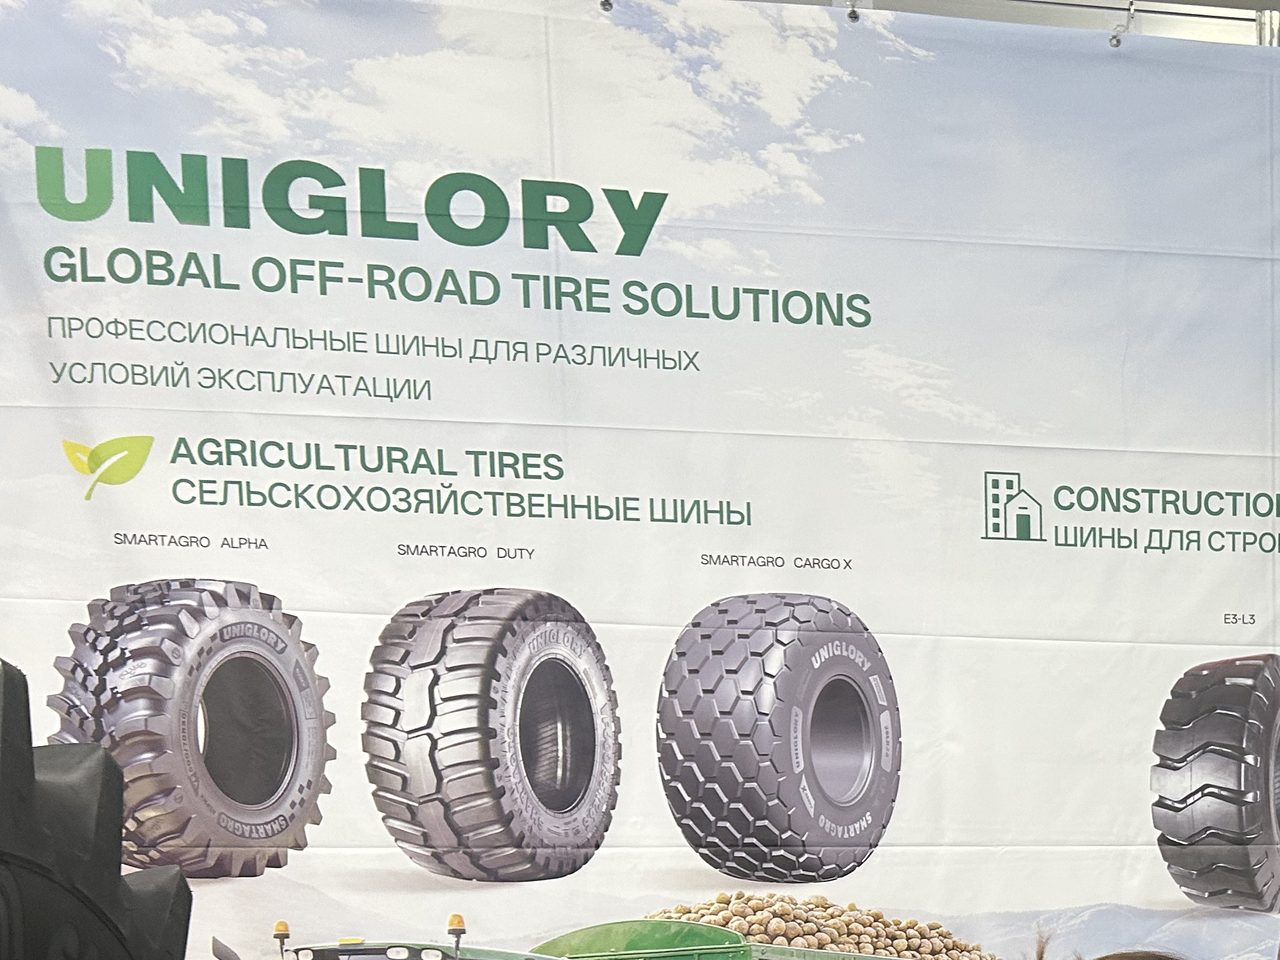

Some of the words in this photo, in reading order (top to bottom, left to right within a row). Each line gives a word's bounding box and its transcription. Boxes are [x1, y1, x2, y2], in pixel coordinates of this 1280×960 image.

[36, 146, 668, 256] UNIGLORY
[44, 246, 240, 290] GLOBAL
[252, 257, 500, 305] OFF-ROAD
[512, 273, 610, 313] TIRE
[623, 281, 871, 328] SOLUTIONS
[48, 317, 368, 353] ПРОФЕССИОНАЛЬНЫЕ
[376, 333, 462, 358] ШИНЫ
[469, 339, 528, 364] ДЛЯ
[536, 343, 700, 371] РАЗЛИЧНЫХ
[49, 362, 190, 388] УСЛОВИЙ
[198, 368, 431, 402] ЭКСПЛУАТАЦИИ
[170, 438, 457, 476] AGRICULTURAL
[465, 451, 564, 480] TIRES
[173, 479, 640, 521] СЕЛЬСКОХОЗЯЙСТВЕННЫЕ
[650, 498, 751, 525] ШИНЫ
[114, 533, 210, 548] SMARTAGRO
[221, 538, 268, 549] ALPHA
[398, 544, 487, 558] SMARTAGRO
[497, 548, 534, 559] DUTY
[1055, 526, 1137, 549] ШИНЫ
[1144, 529, 1200, 554] ДЛЯ
[701, 554, 784, 567] SMARTAGRO
[794, 557, 840, 569] CARGO
[843, 559, 852, 569] X
[1224, 614, 1255, 624] E3-L3
[223, 623, 285, 651] UNIGLORY
[528, 629, 586, 658] UNIGLORY
[811, 640, 872, 672] UNIGLORY
[218, 815, 289, 838] SMARTAGRO
[817, 811, 872, 839] SMARTAGRO
